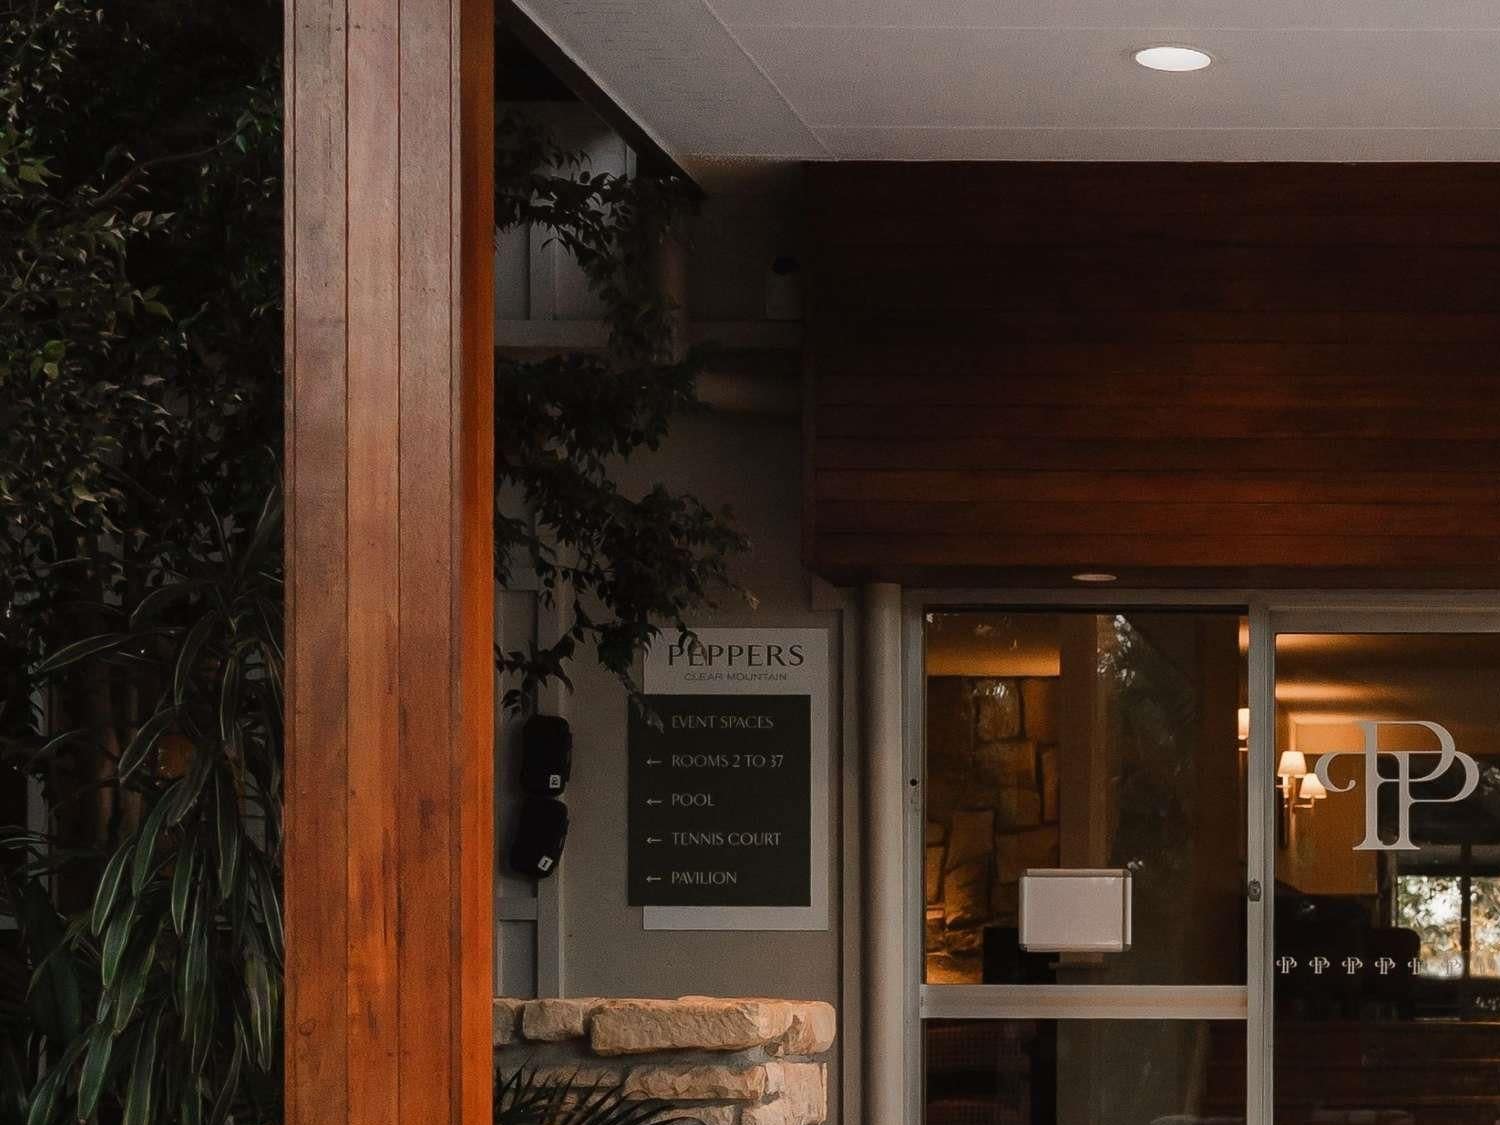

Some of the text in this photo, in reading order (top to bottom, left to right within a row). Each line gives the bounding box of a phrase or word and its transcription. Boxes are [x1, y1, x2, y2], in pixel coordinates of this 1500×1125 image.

[667, 644, 805, 667] PEPPERS
[684, 672, 787, 681] CLEAR MOUNTAIN
[672, 716, 774, 729] EVENT SPACES
[672, 754, 784, 768] ROOMS 2 TO 37
[672, 793, 716, 807] POOL
[672, 832, 782, 846] TENNIS COURT
[671, 871, 737, 884] PAVILION
